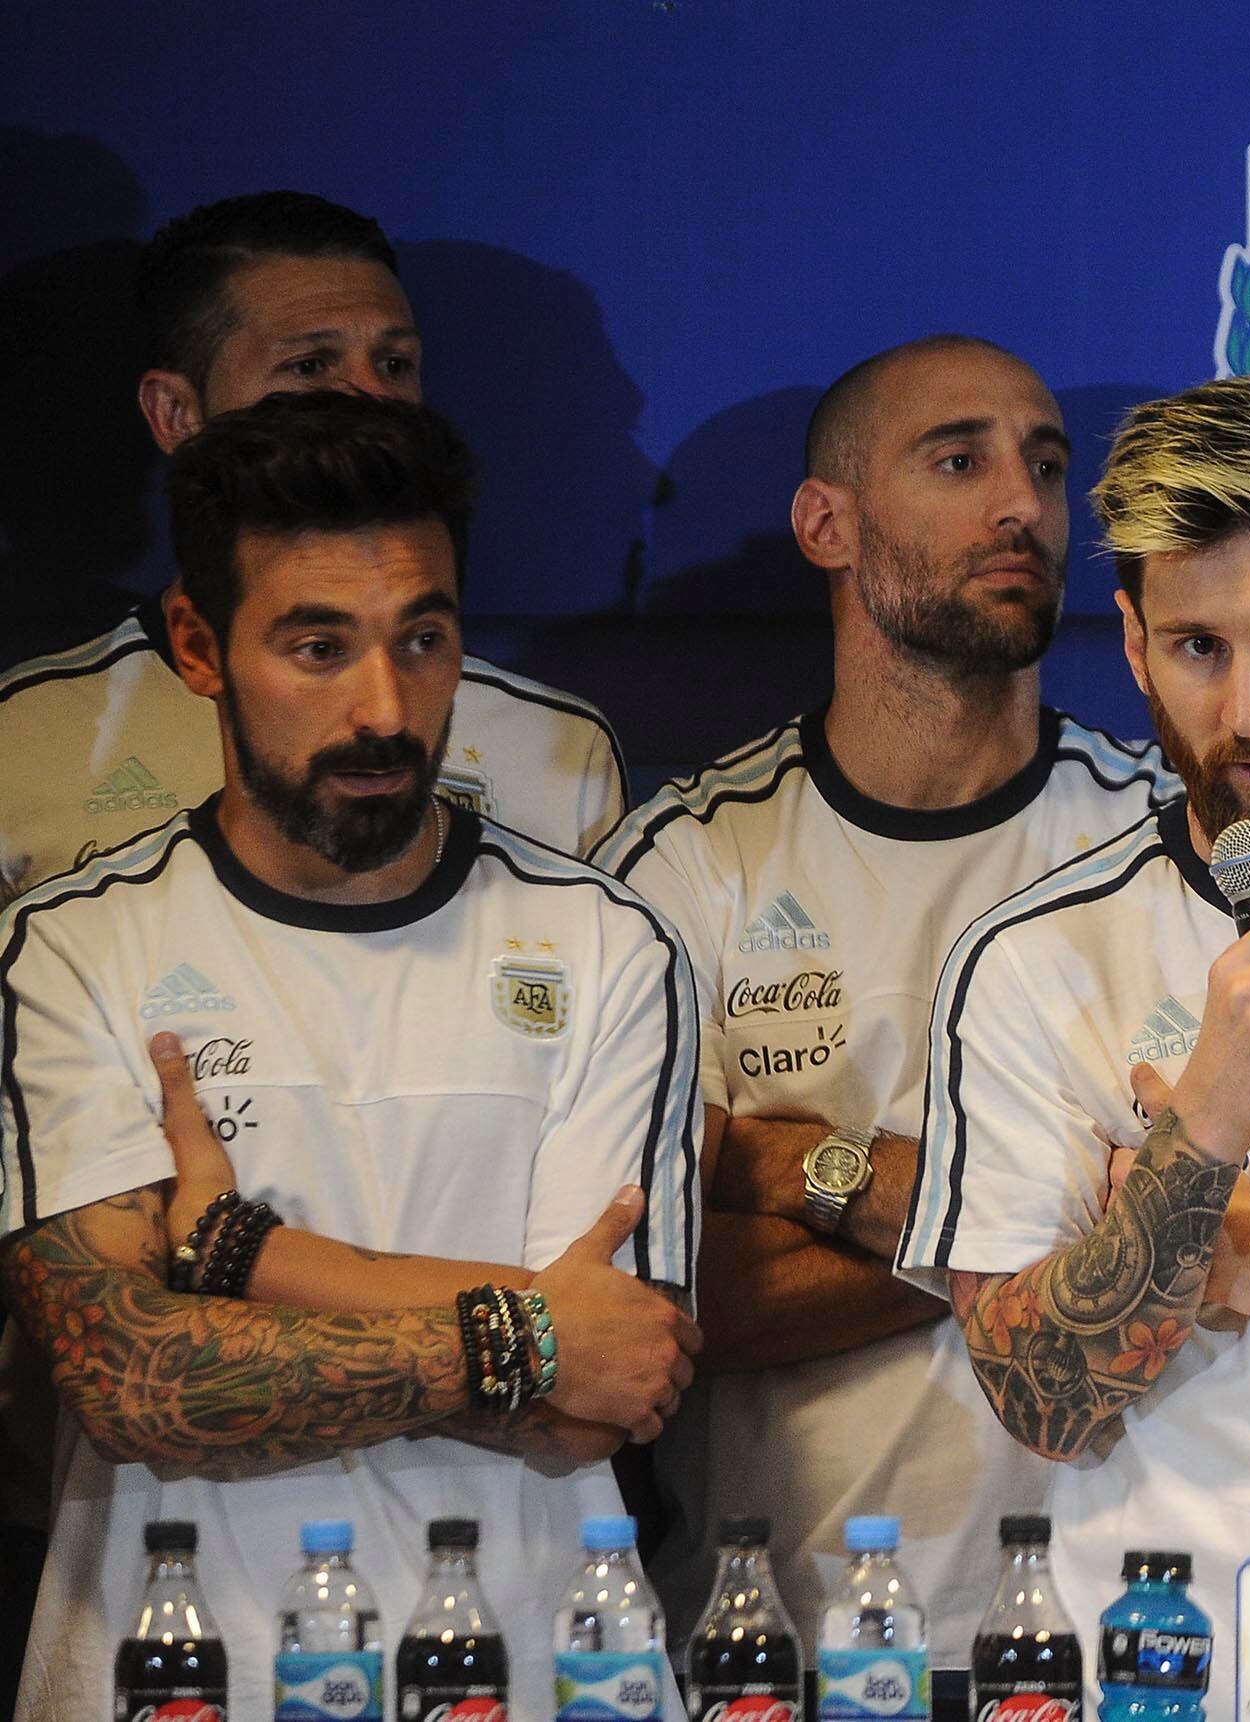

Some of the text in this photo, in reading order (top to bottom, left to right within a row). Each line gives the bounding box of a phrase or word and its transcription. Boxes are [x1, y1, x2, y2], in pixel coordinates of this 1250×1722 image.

[84, 788, 178, 815] adidas
[738, 928, 831, 953] adidas
[140, 991, 237, 1019] adidas
[513, 980, 553, 1014] AFA
[727, 970, 843, 1018] Coca-Cola
[739, 1044, 830, 1077] Claro
[1127, 1032, 1201, 1065] adid
